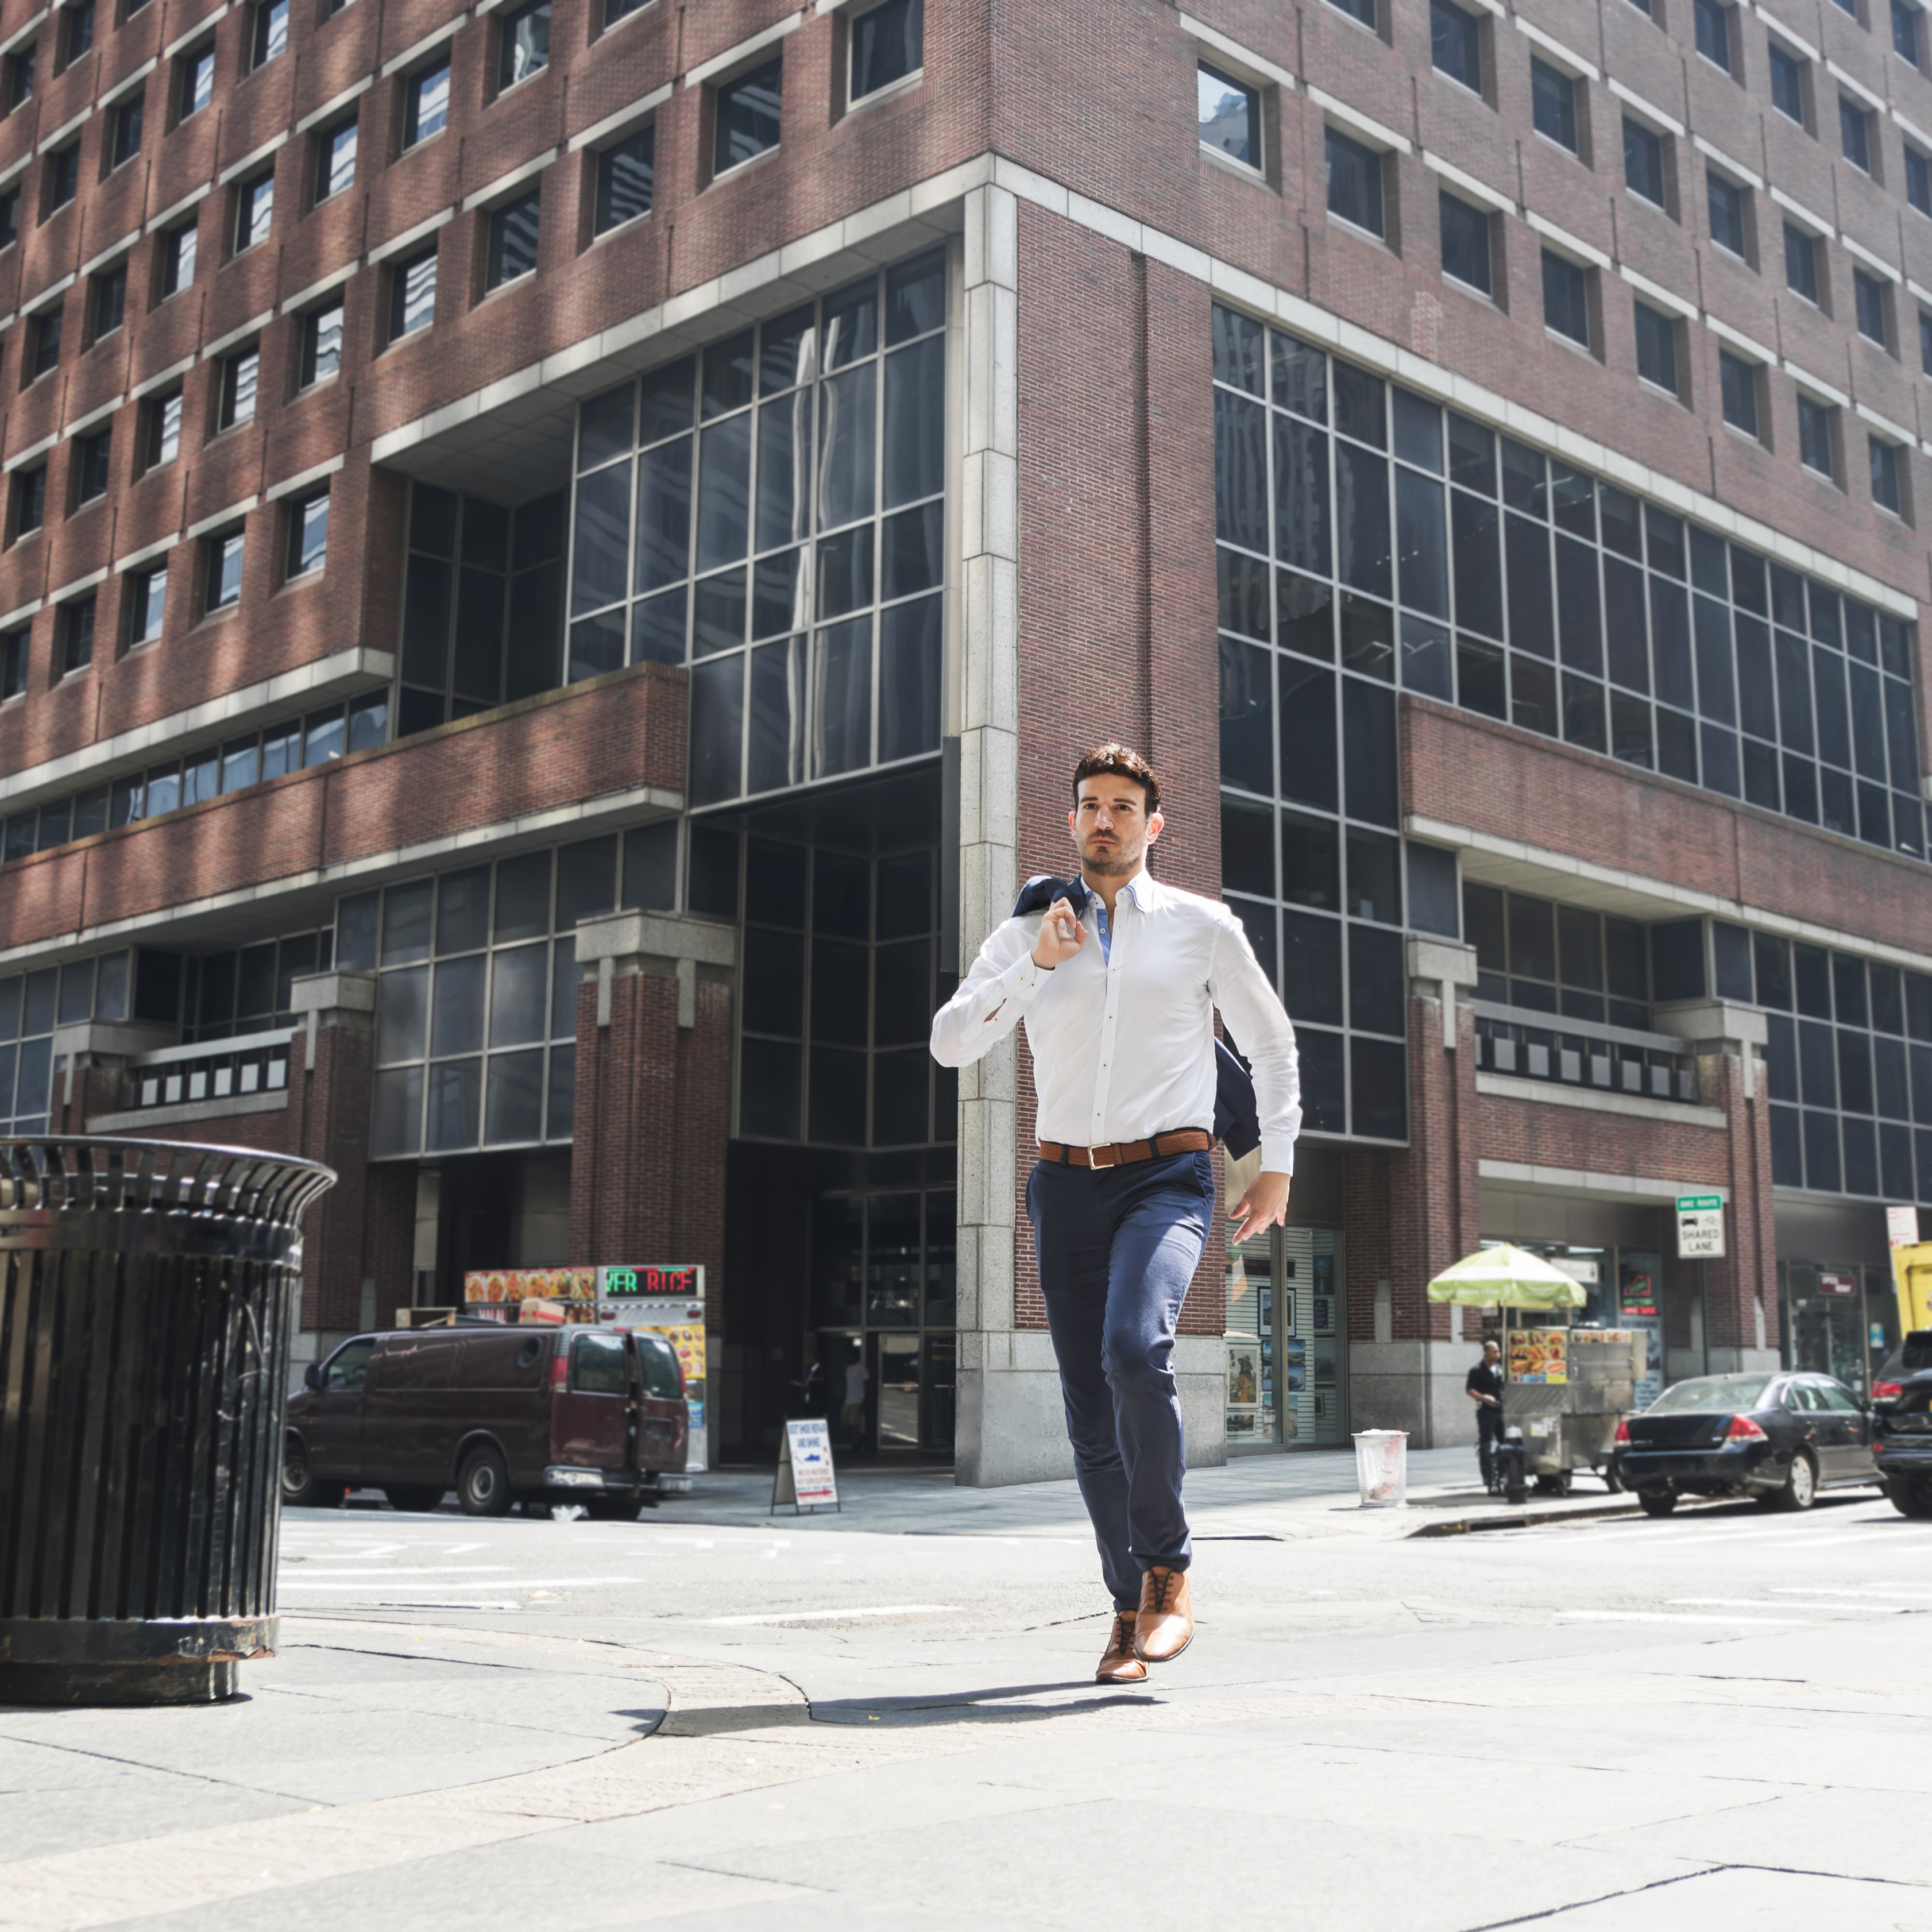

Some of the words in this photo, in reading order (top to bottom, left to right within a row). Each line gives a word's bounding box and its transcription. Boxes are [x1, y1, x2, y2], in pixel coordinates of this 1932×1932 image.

[1697, 1199, 1718, 1207] ROUTE
[1682, 1229, 1719, 1240] SHARED
[1688, 1242, 1714, 1251] LANE
